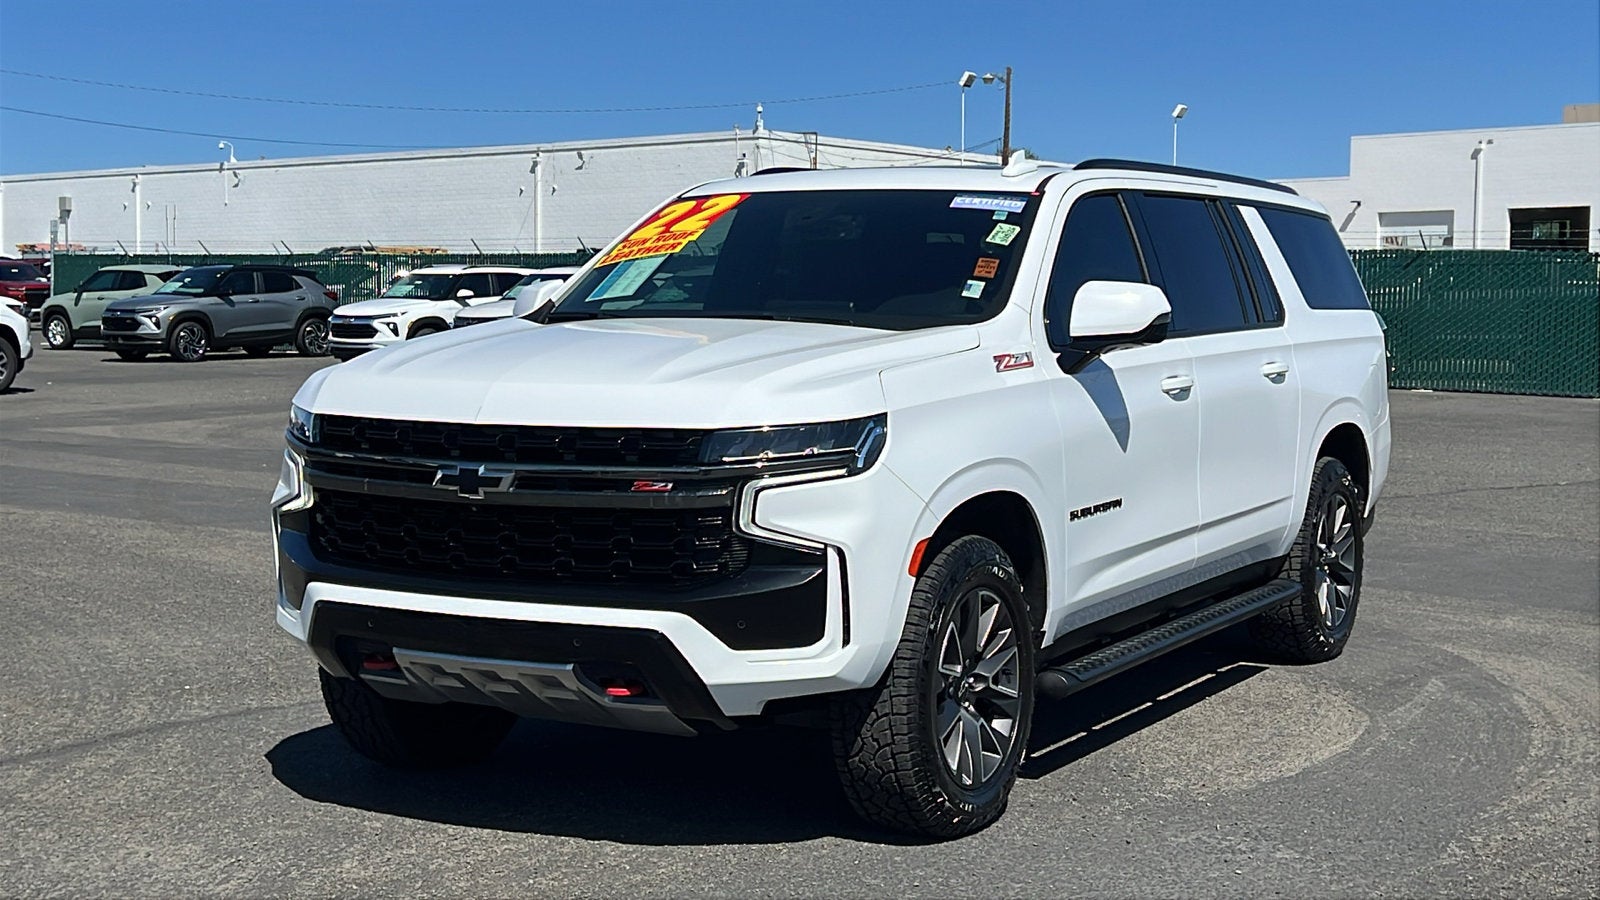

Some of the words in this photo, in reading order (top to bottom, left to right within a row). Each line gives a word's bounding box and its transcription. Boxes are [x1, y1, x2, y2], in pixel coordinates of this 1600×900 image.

[956, 197, 1022, 208] CERTIFIED
[628, 194, 741, 240] 22
[621, 238, 649, 249] SUN
[652, 231, 698, 243] ROOF
[600, 242, 683, 264] LEATHER
[993, 351, 1034, 373] Z71
[631, 481, 673, 491] Z71
[1069, 497, 1123, 522] SUBURBAN
